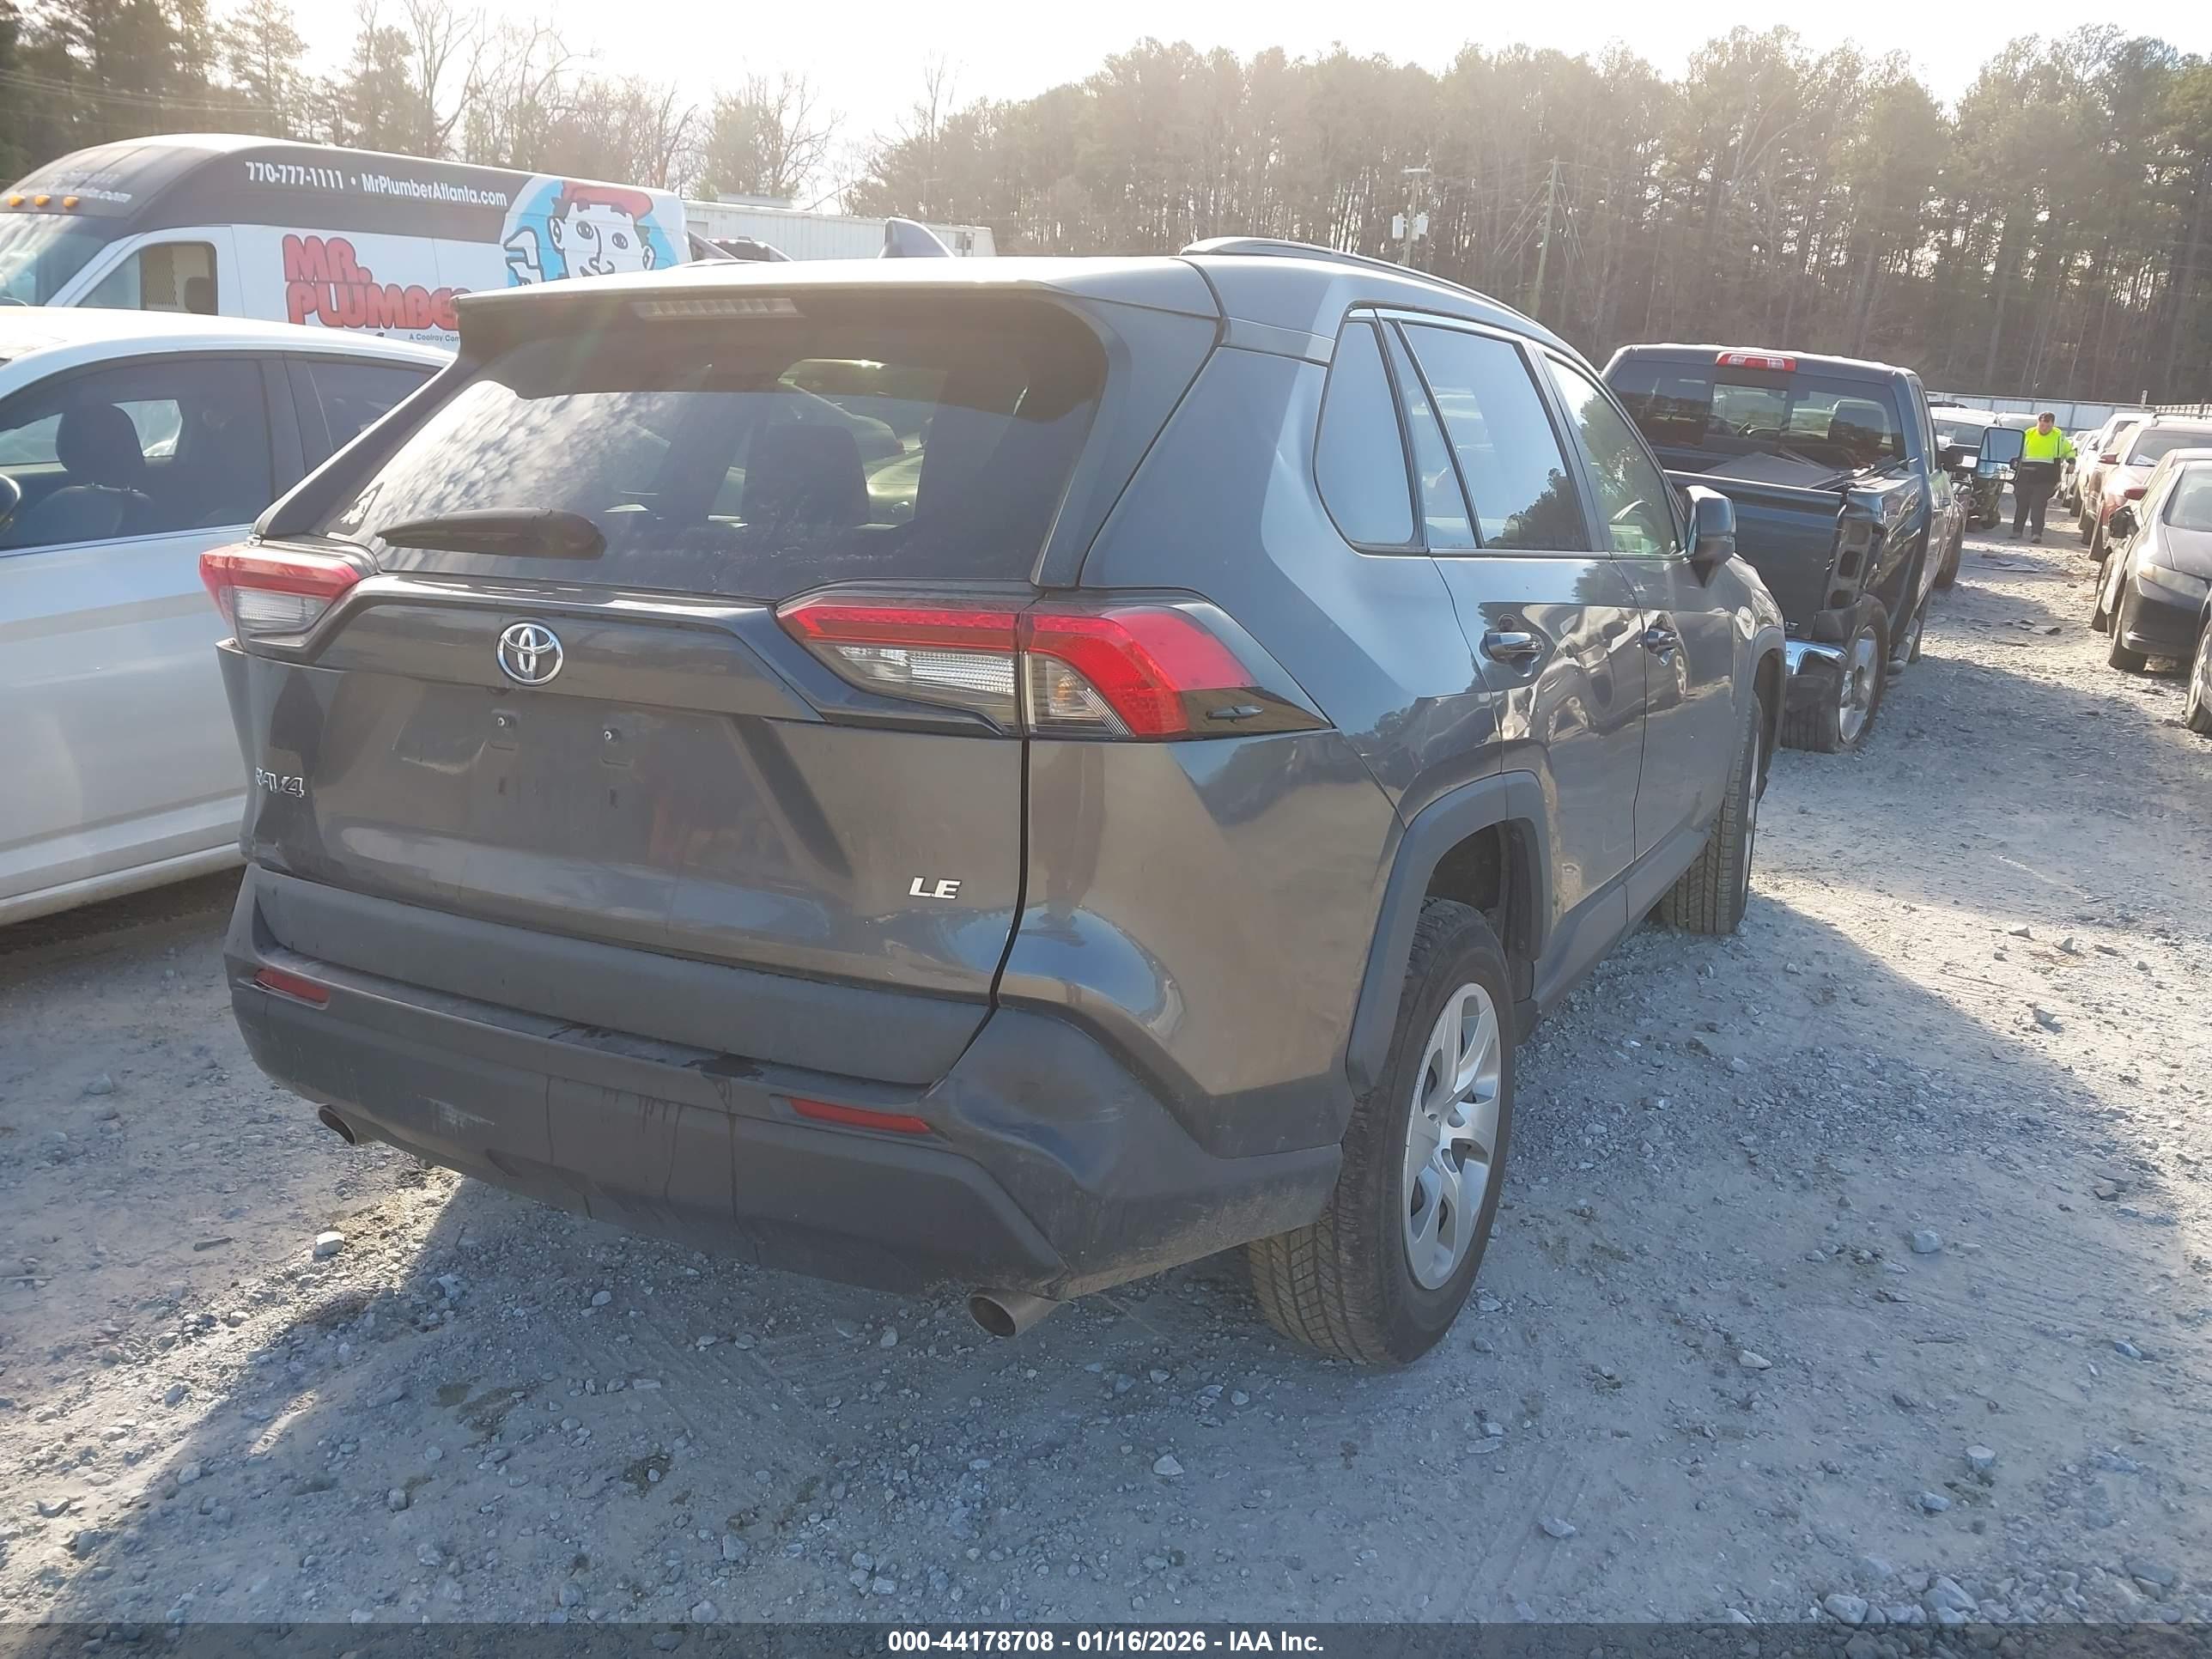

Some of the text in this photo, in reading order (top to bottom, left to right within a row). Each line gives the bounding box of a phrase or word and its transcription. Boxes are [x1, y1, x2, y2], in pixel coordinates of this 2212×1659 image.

[245, 161, 507, 207] 770-777-1111 MrPlumberAtlanta.com
[283, 234, 373, 283] MR.
[286, 282, 471, 331] PLUMBE
[416, 333, 442, 342] Coolray
[909, 877, 962, 899] LE
